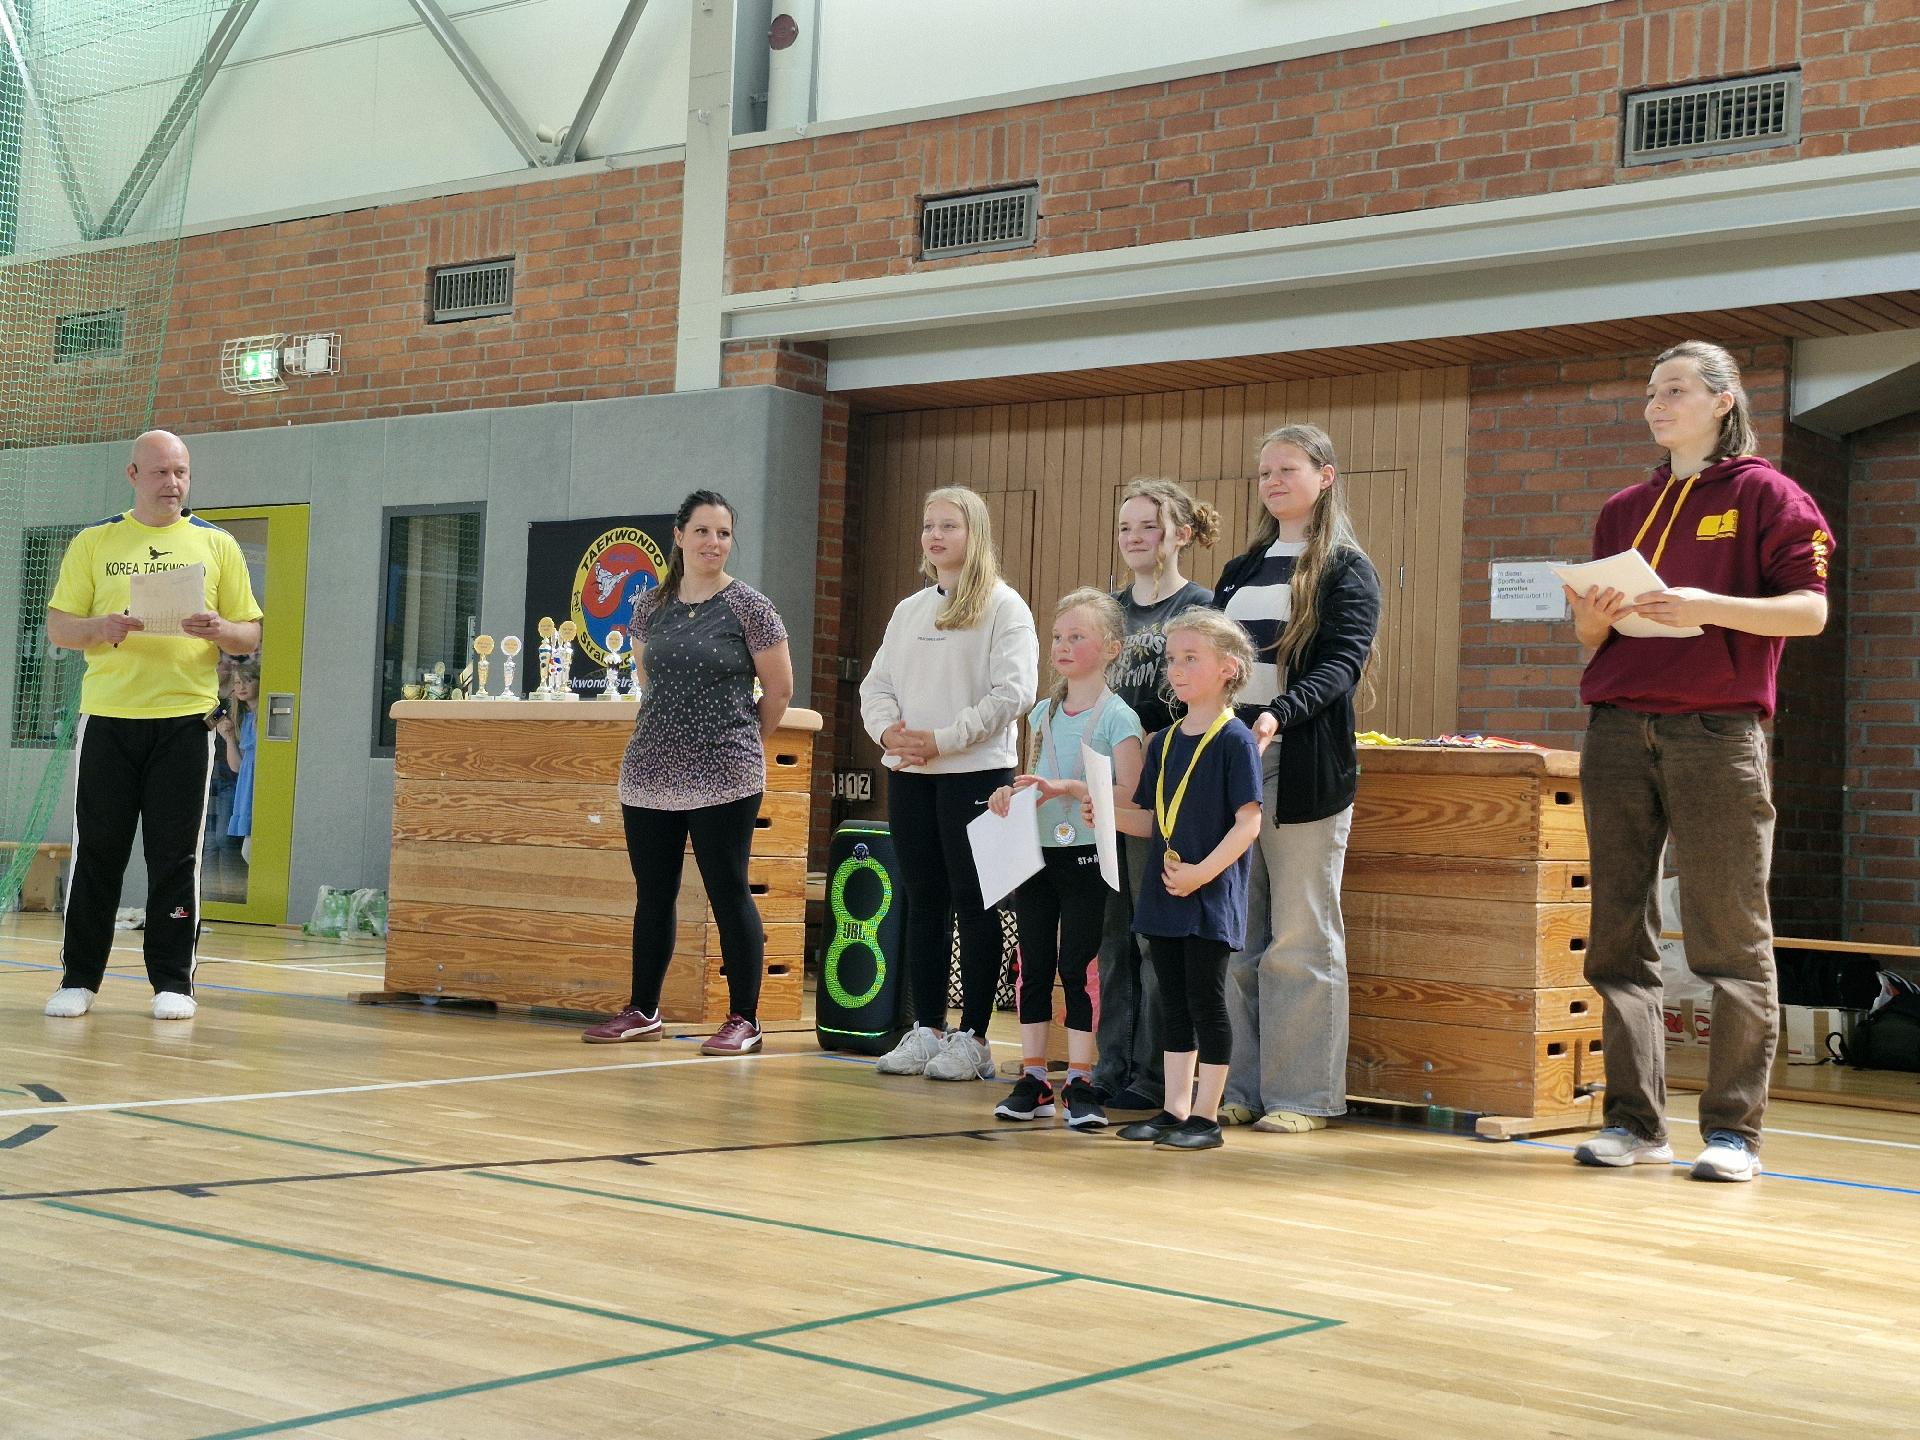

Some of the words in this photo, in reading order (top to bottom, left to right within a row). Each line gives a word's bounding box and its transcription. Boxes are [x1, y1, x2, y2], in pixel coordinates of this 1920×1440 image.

[581, 529, 664, 571] TAEKWONDO
[106, 562, 139, 576] KOREA
[843, 922, 866, 940] JBL
